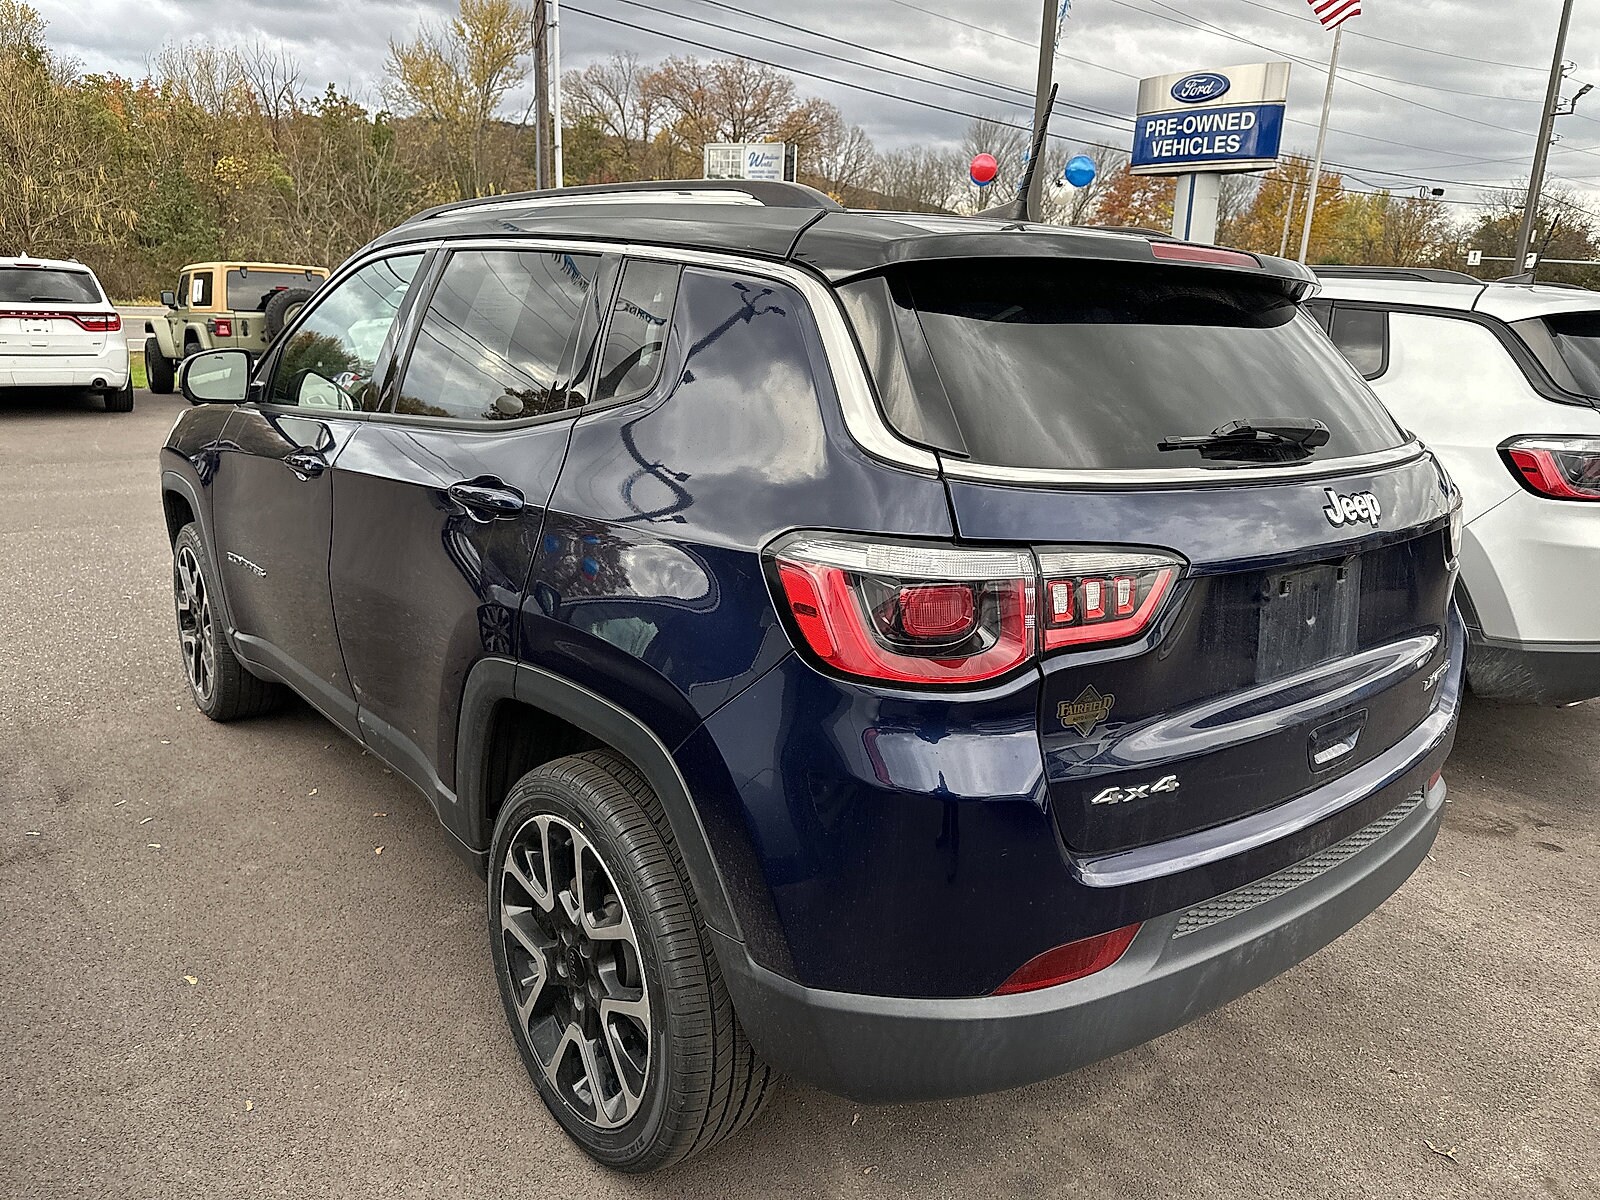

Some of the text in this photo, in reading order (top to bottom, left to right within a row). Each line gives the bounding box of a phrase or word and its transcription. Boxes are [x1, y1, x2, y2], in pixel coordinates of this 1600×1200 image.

[1181, 78, 1215, 97] Ford
[1145, 112, 1256, 138] PRE-OWNED
[1151, 135, 1240, 158] VEHICLES
[1323, 487, 1381, 528] Jeep
[1060, 696, 1112, 717] FAIRFIELD
[1091, 774, 1180, 805] 4x4
